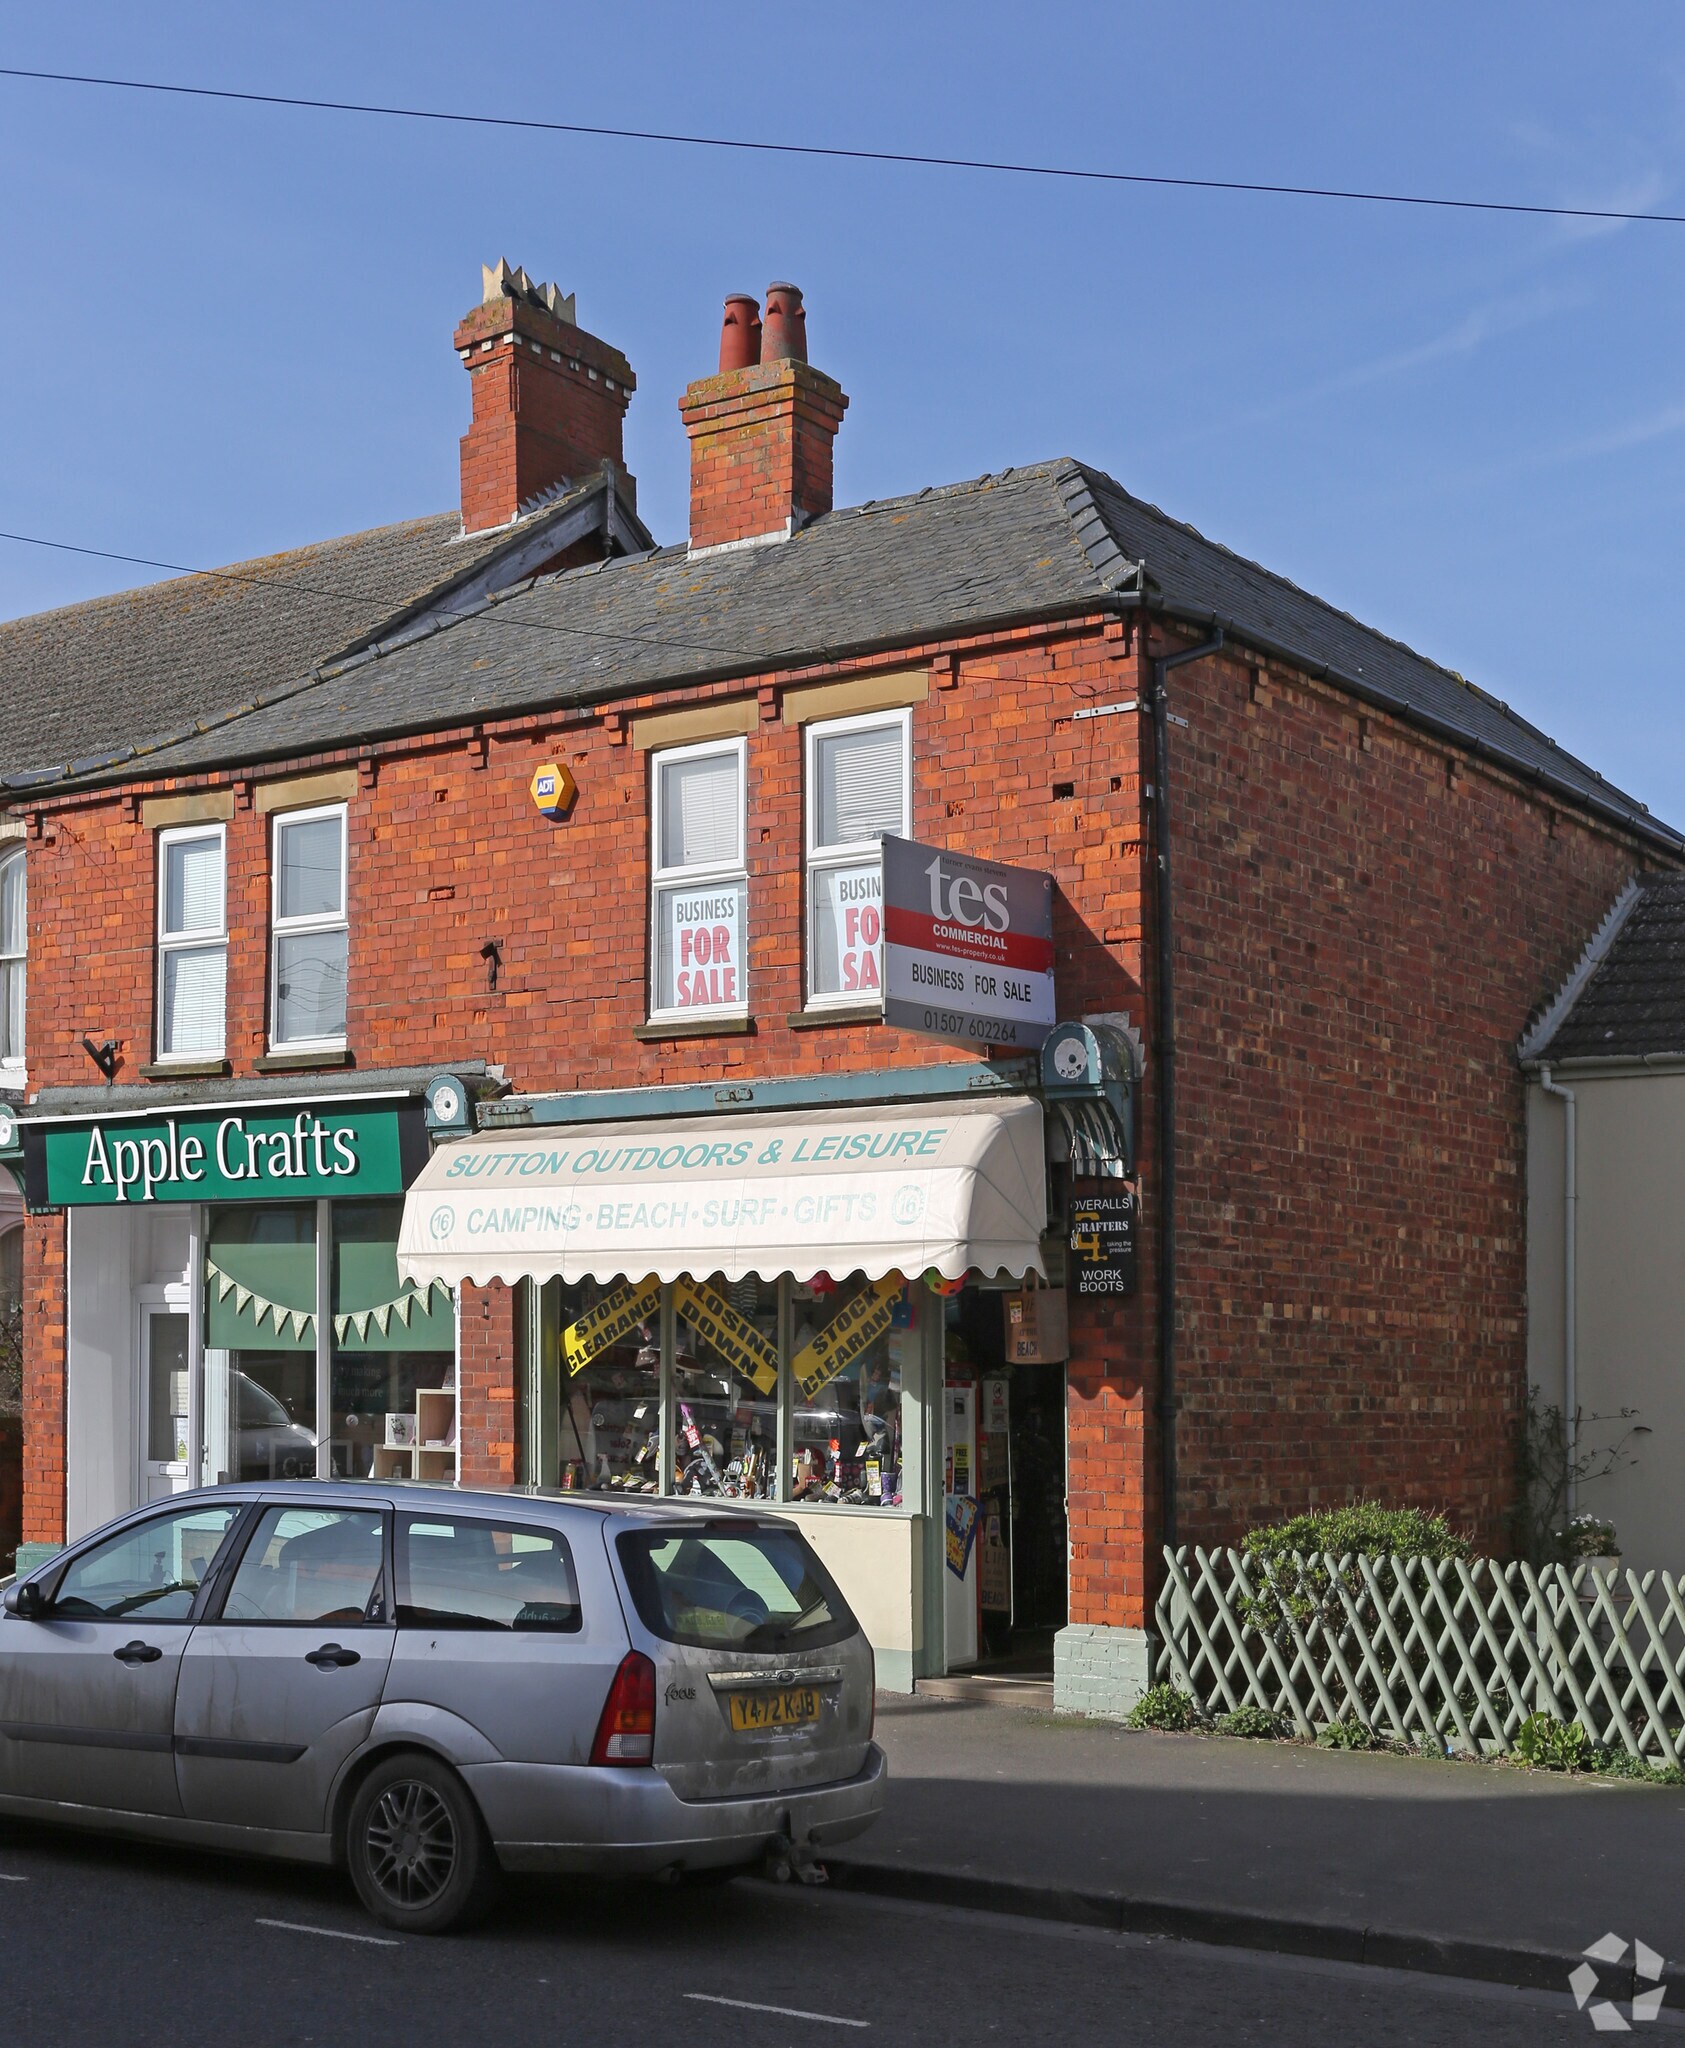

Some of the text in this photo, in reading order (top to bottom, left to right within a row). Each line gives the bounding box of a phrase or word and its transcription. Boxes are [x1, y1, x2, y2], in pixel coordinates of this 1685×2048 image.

[537, 779, 555, 795] ADT
[942, 856, 1008, 878] turner evans stevens
[839, 876, 881, 902] BUSIN
[924, 855, 1010, 933] tes
[676, 896, 735, 924] BUSINESS
[845, 905, 880, 948] FO
[680, 925, 732, 967] FOR
[932, 924, 1008, 950] COMMERCIAL
[935, 942, 1006, 962] www.tes-property.co.uk
[677, 967, 737, 1007] SALE
[843, 950, 880, 992] SA
[912, 963, 1032, 1003] BUSINESS FOR SALE
[924, 1010, 1017, 1042] 01507 602264
[81, 1110, 359, 1201] Apple Crafts
[446, 1128, 948, 1178] SUTTON OUTDOORS & LEISURE
[434, 1213, 450, 1232] 16
[466, 1203, 583, 1235] CAMPING
[596, 1201, 689, 1230] BEACH
[702, 1197, 778, 1228] SURF
[793, 1191, 877, 1225] GIFTS
[1075, 1220, 1129, 1233] GRAFTERS
[1109, 1247, 1132, 1255] pressure
[1079, 1281, 1124, 1293] BOOTS
[1081, 1269, 1122, 1281] WORK
[574, 1284, 638, 1339] STOCK
[678, 1273, 778, 1371] CLOSING
[812, 1284, 881, 1356] STOCK
[680, 1299, 759, 1379] DOWN
[801, 1289, 902, 1396] CLEARANC
[1017, 1341, 1038, 1357] BEACH
[738, 1691, 815, 1725] Y472 KJB
